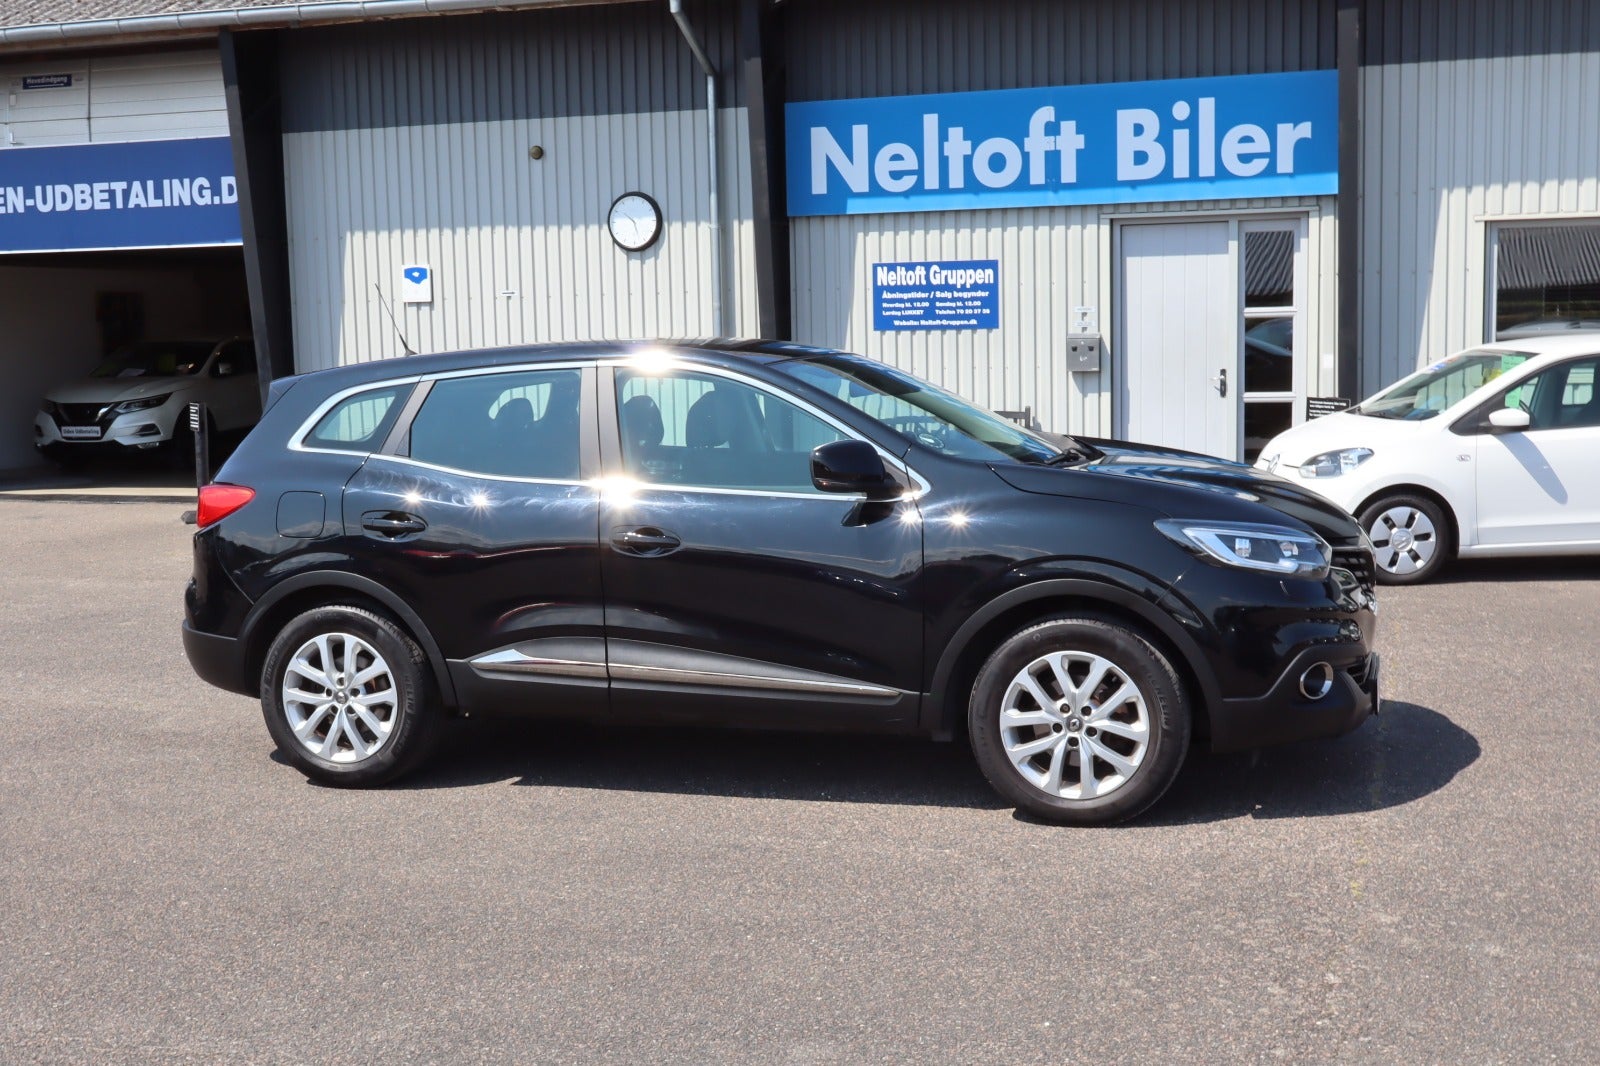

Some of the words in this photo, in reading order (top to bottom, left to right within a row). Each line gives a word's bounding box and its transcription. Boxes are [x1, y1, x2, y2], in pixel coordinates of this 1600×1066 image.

[810, 106, 1085, 195] Neltoft
[1116, 97, 1312, 181] Biler
[0, 176, 238, 214] N-UDBETALING.D
[877, 265, 927, 287] Neltoft
[929, 264, 995, 289] Gruppen
[882, 290, 930, 300] Åbningstider
[935, 290, 953, 299] Salg
[953, 289, 990, 299] begynder
